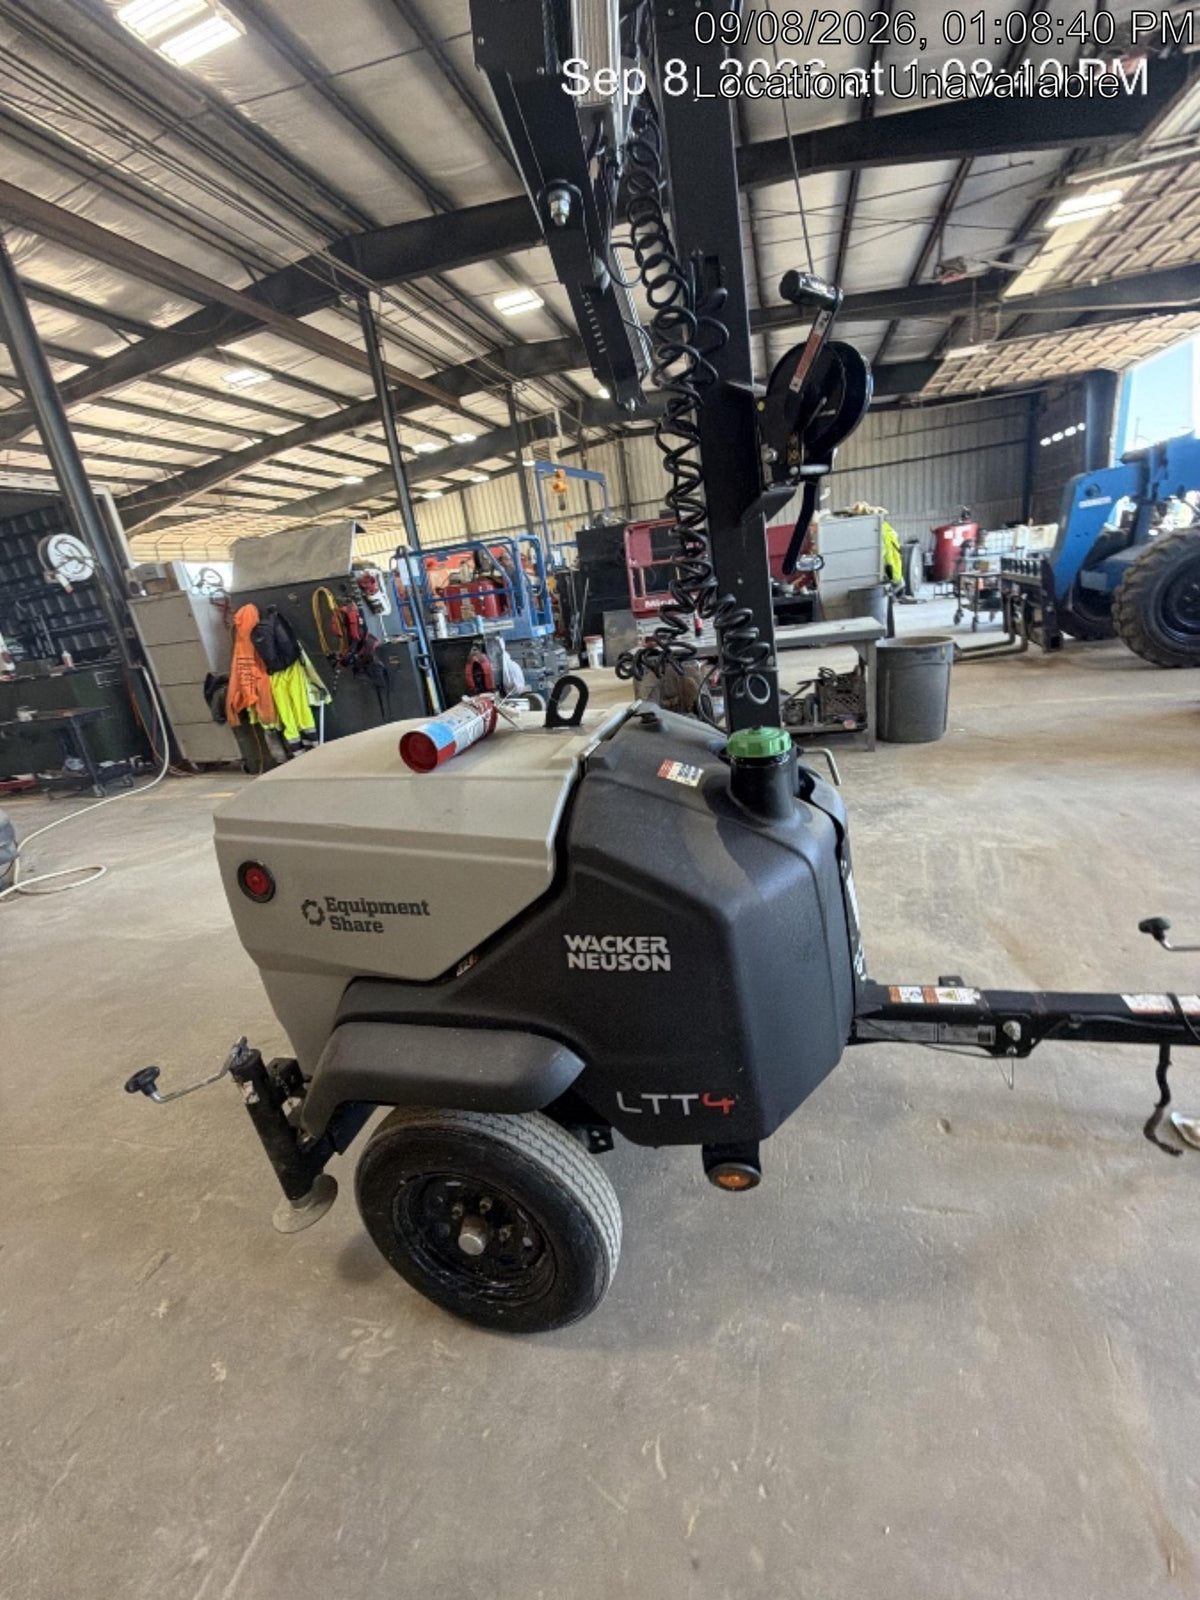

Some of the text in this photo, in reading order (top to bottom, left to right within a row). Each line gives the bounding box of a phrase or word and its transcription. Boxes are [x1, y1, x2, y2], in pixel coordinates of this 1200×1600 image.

[324, 896, 430, 918] Equipment
[329, 915, 384, 933] Share
[563, 934, 670, 954] WACKER
[566, 953, 671, 972] NEUSON
[616, 1091, 735, 1116] LTT4
